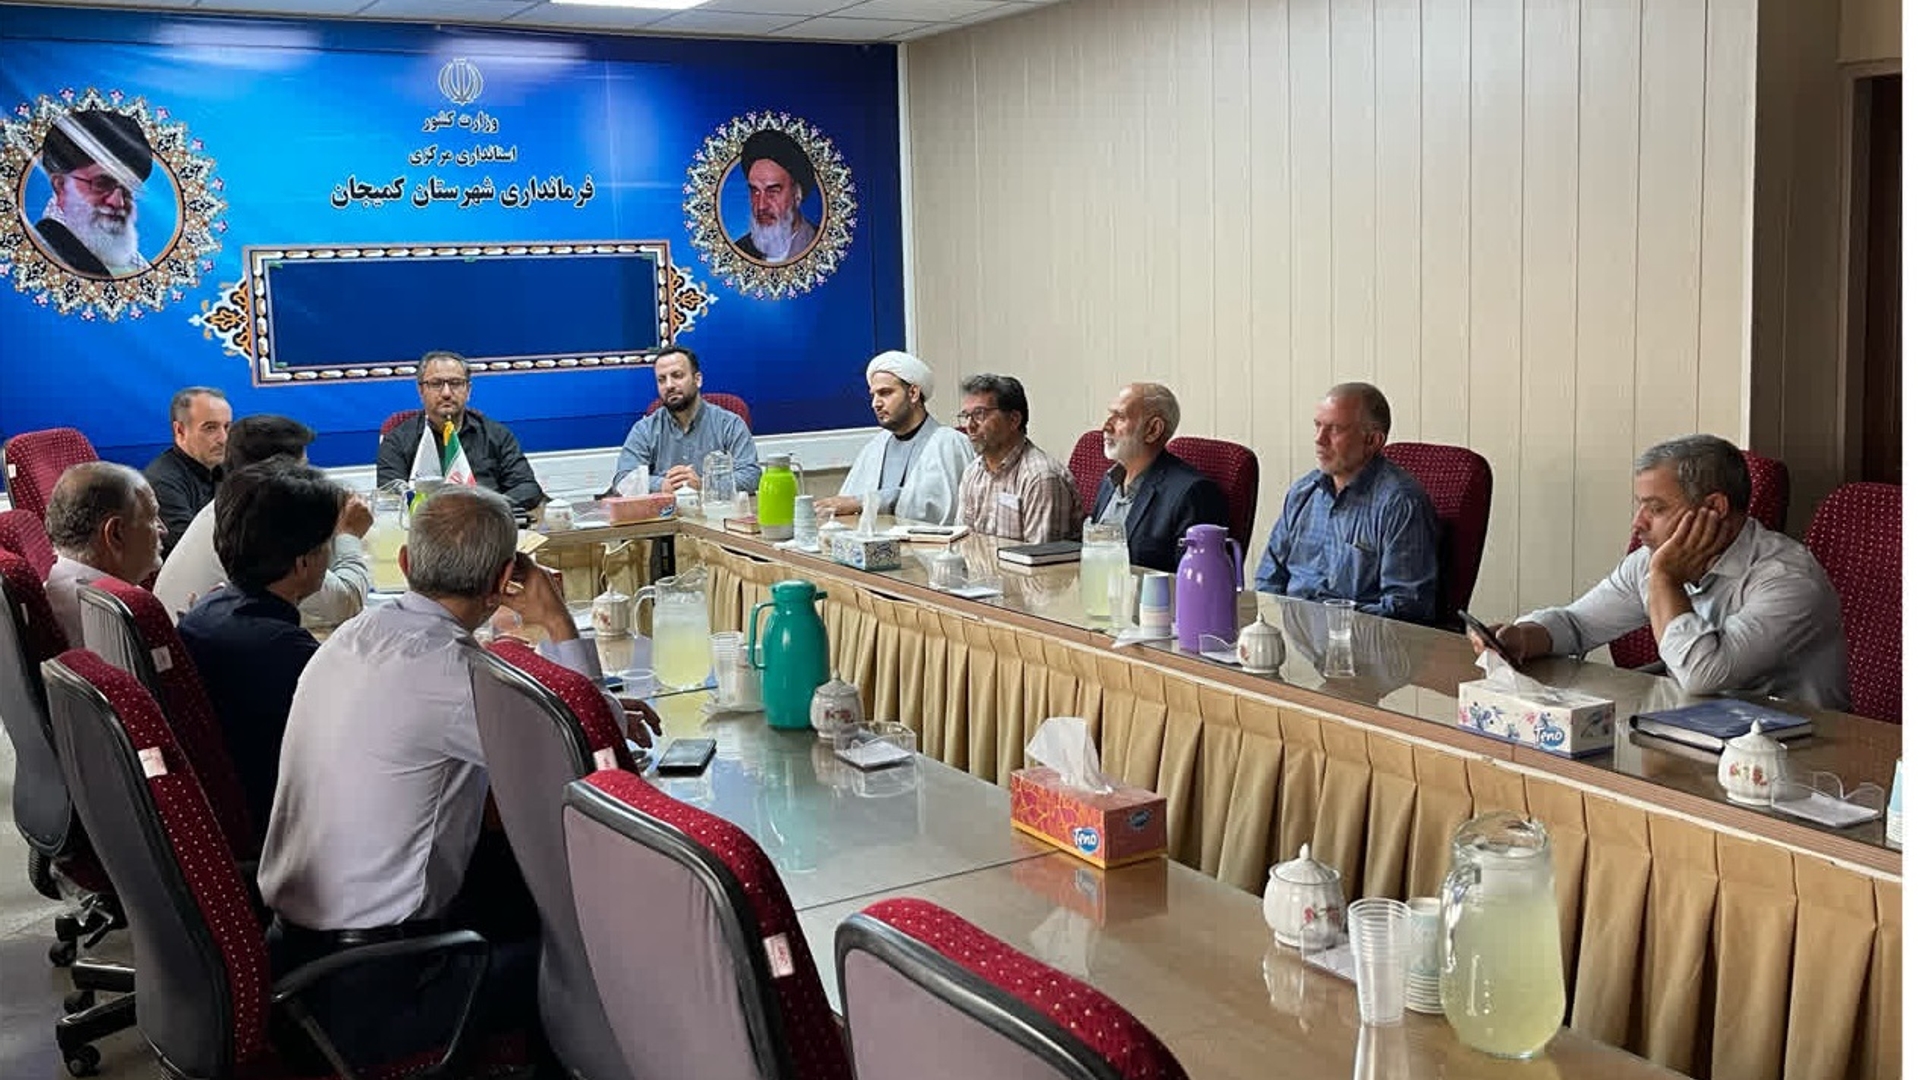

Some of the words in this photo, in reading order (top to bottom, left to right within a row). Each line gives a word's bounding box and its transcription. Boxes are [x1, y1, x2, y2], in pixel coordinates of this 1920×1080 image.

[422, 110, 454, 132] کشور
[457, 112, 499, 132] وزارت
[409, 146, 452, 165] مرکزی
[456, 146, 516, 165] استانداری
[331, 174, 405, 208] کمیجان
[412, 175, 495, 208] شهرستان
[500, 174, 594, 208] فرمانداری
[1534, 727, 1563, 745] Teno
[1074, 827, 1097, 846] Teno
